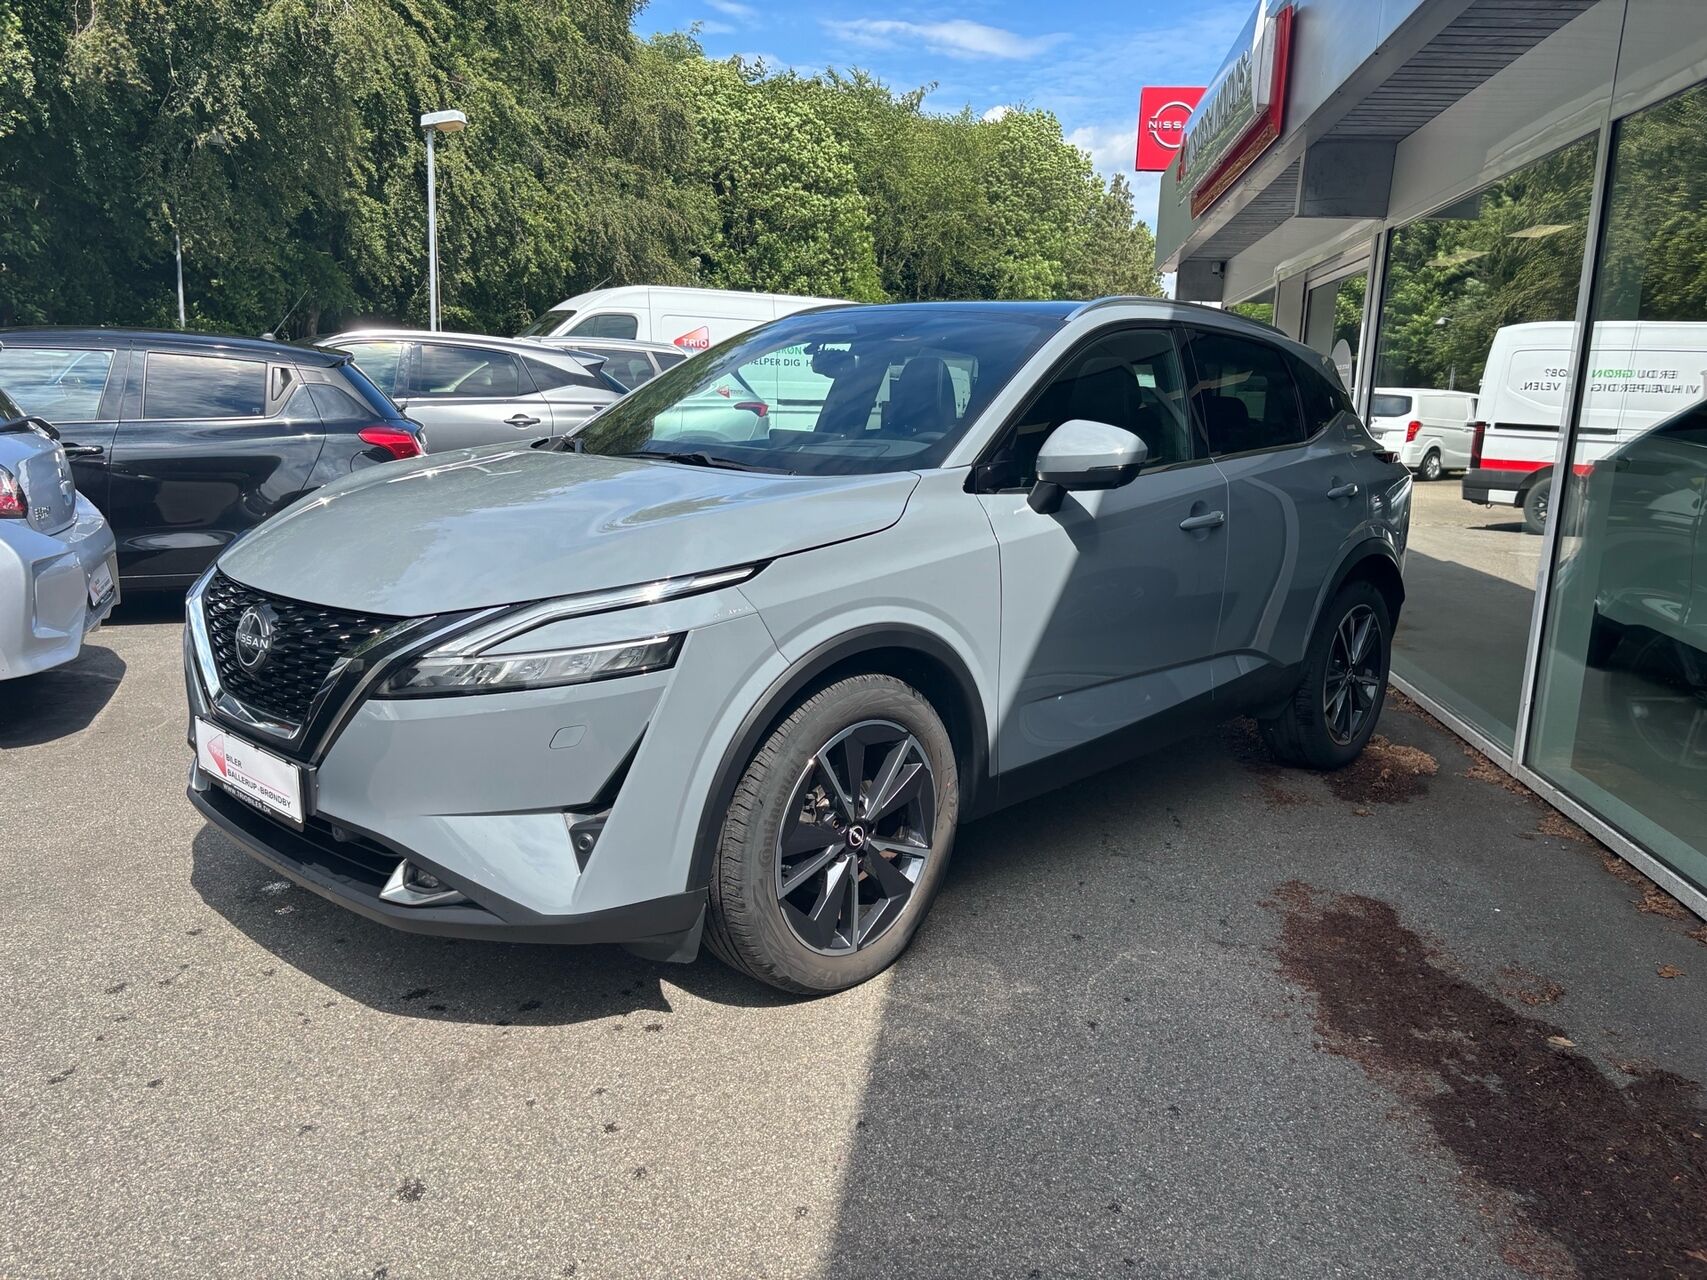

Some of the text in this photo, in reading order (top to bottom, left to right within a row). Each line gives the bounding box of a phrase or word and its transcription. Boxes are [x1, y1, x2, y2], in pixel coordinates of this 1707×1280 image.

[1148, 120, 1185, 129] NISS
[683, 338, 708, 348] TRIO
[783, 358, 800, 367] DIG
[239, 632, 269, 649] ISSAN
[225, 753, 243, 768] BILER
